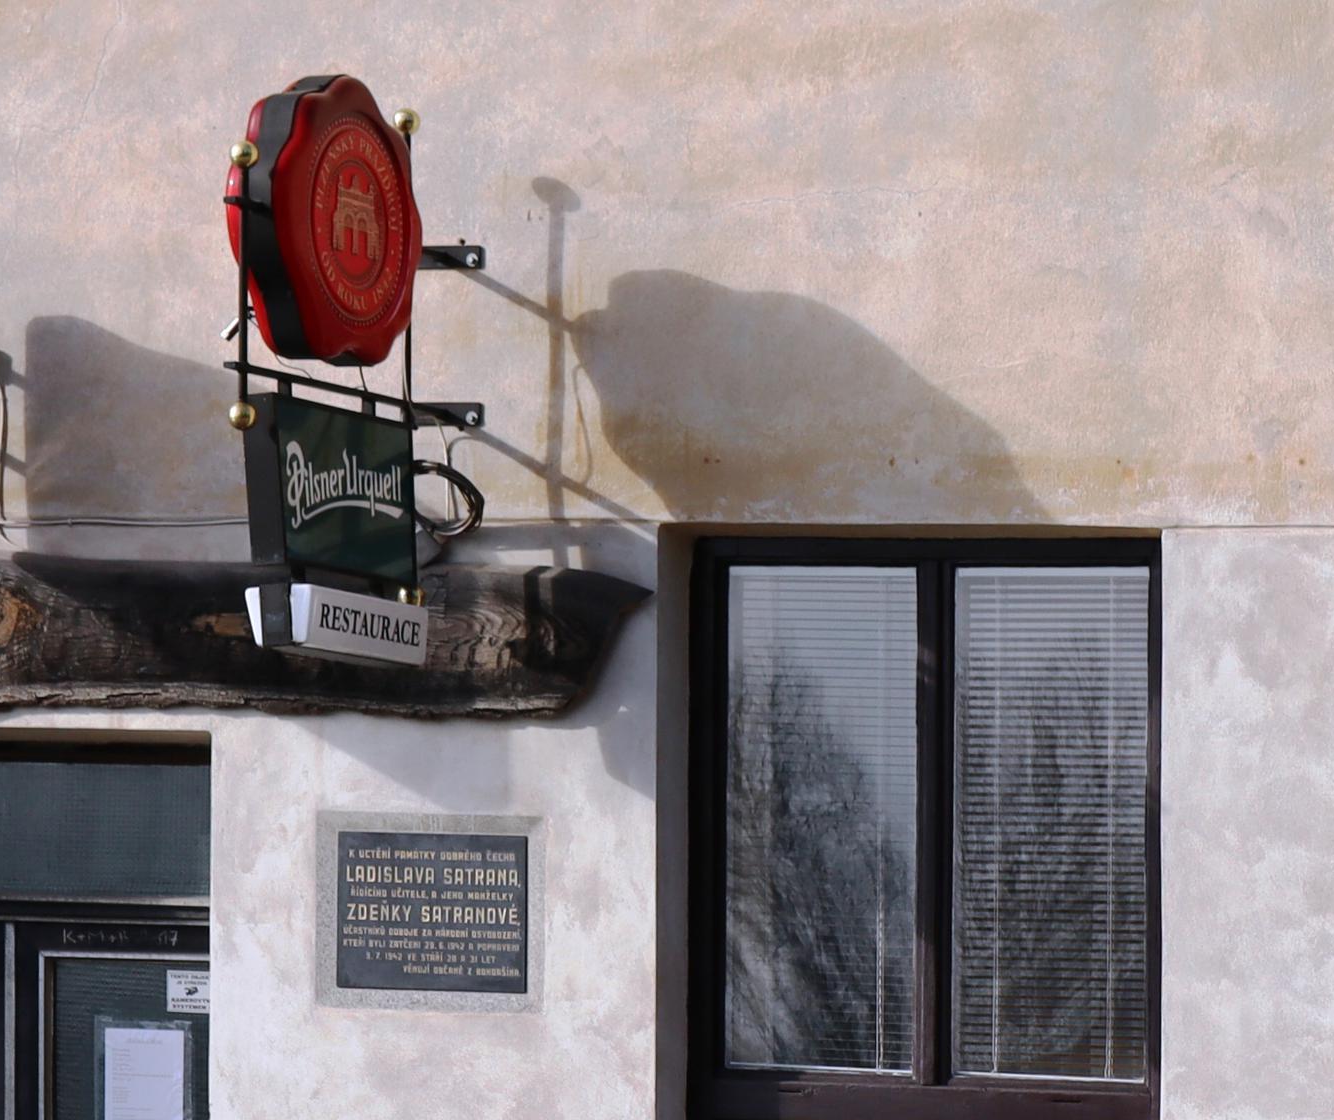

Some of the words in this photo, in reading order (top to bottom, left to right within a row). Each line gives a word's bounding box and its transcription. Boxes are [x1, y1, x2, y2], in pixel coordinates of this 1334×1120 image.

[337, 282, 369, 311] ROKU
[285, 440, 345, 529] Pilsner
[343, 448, 402, 518] Urquell
[319, 602, 421, 648] RESTAURACE
[348, 848, 355, 858] K
[346, 865, 435, 885] LADISLAVA
[443, 867, 522, 889] SATRANA,
[441, 890, 463, 900] JEHO
[346, 900, 412, 921] ZDEŇKY
[421, 903, 522, 926] SATRANOVÉ,
[388, 926, 419, 937] ODBOJE
[421, 928, 433, 937] ZA
[368, 939, 386, 948] BYLI
[481, 954, 497, 964] LET
